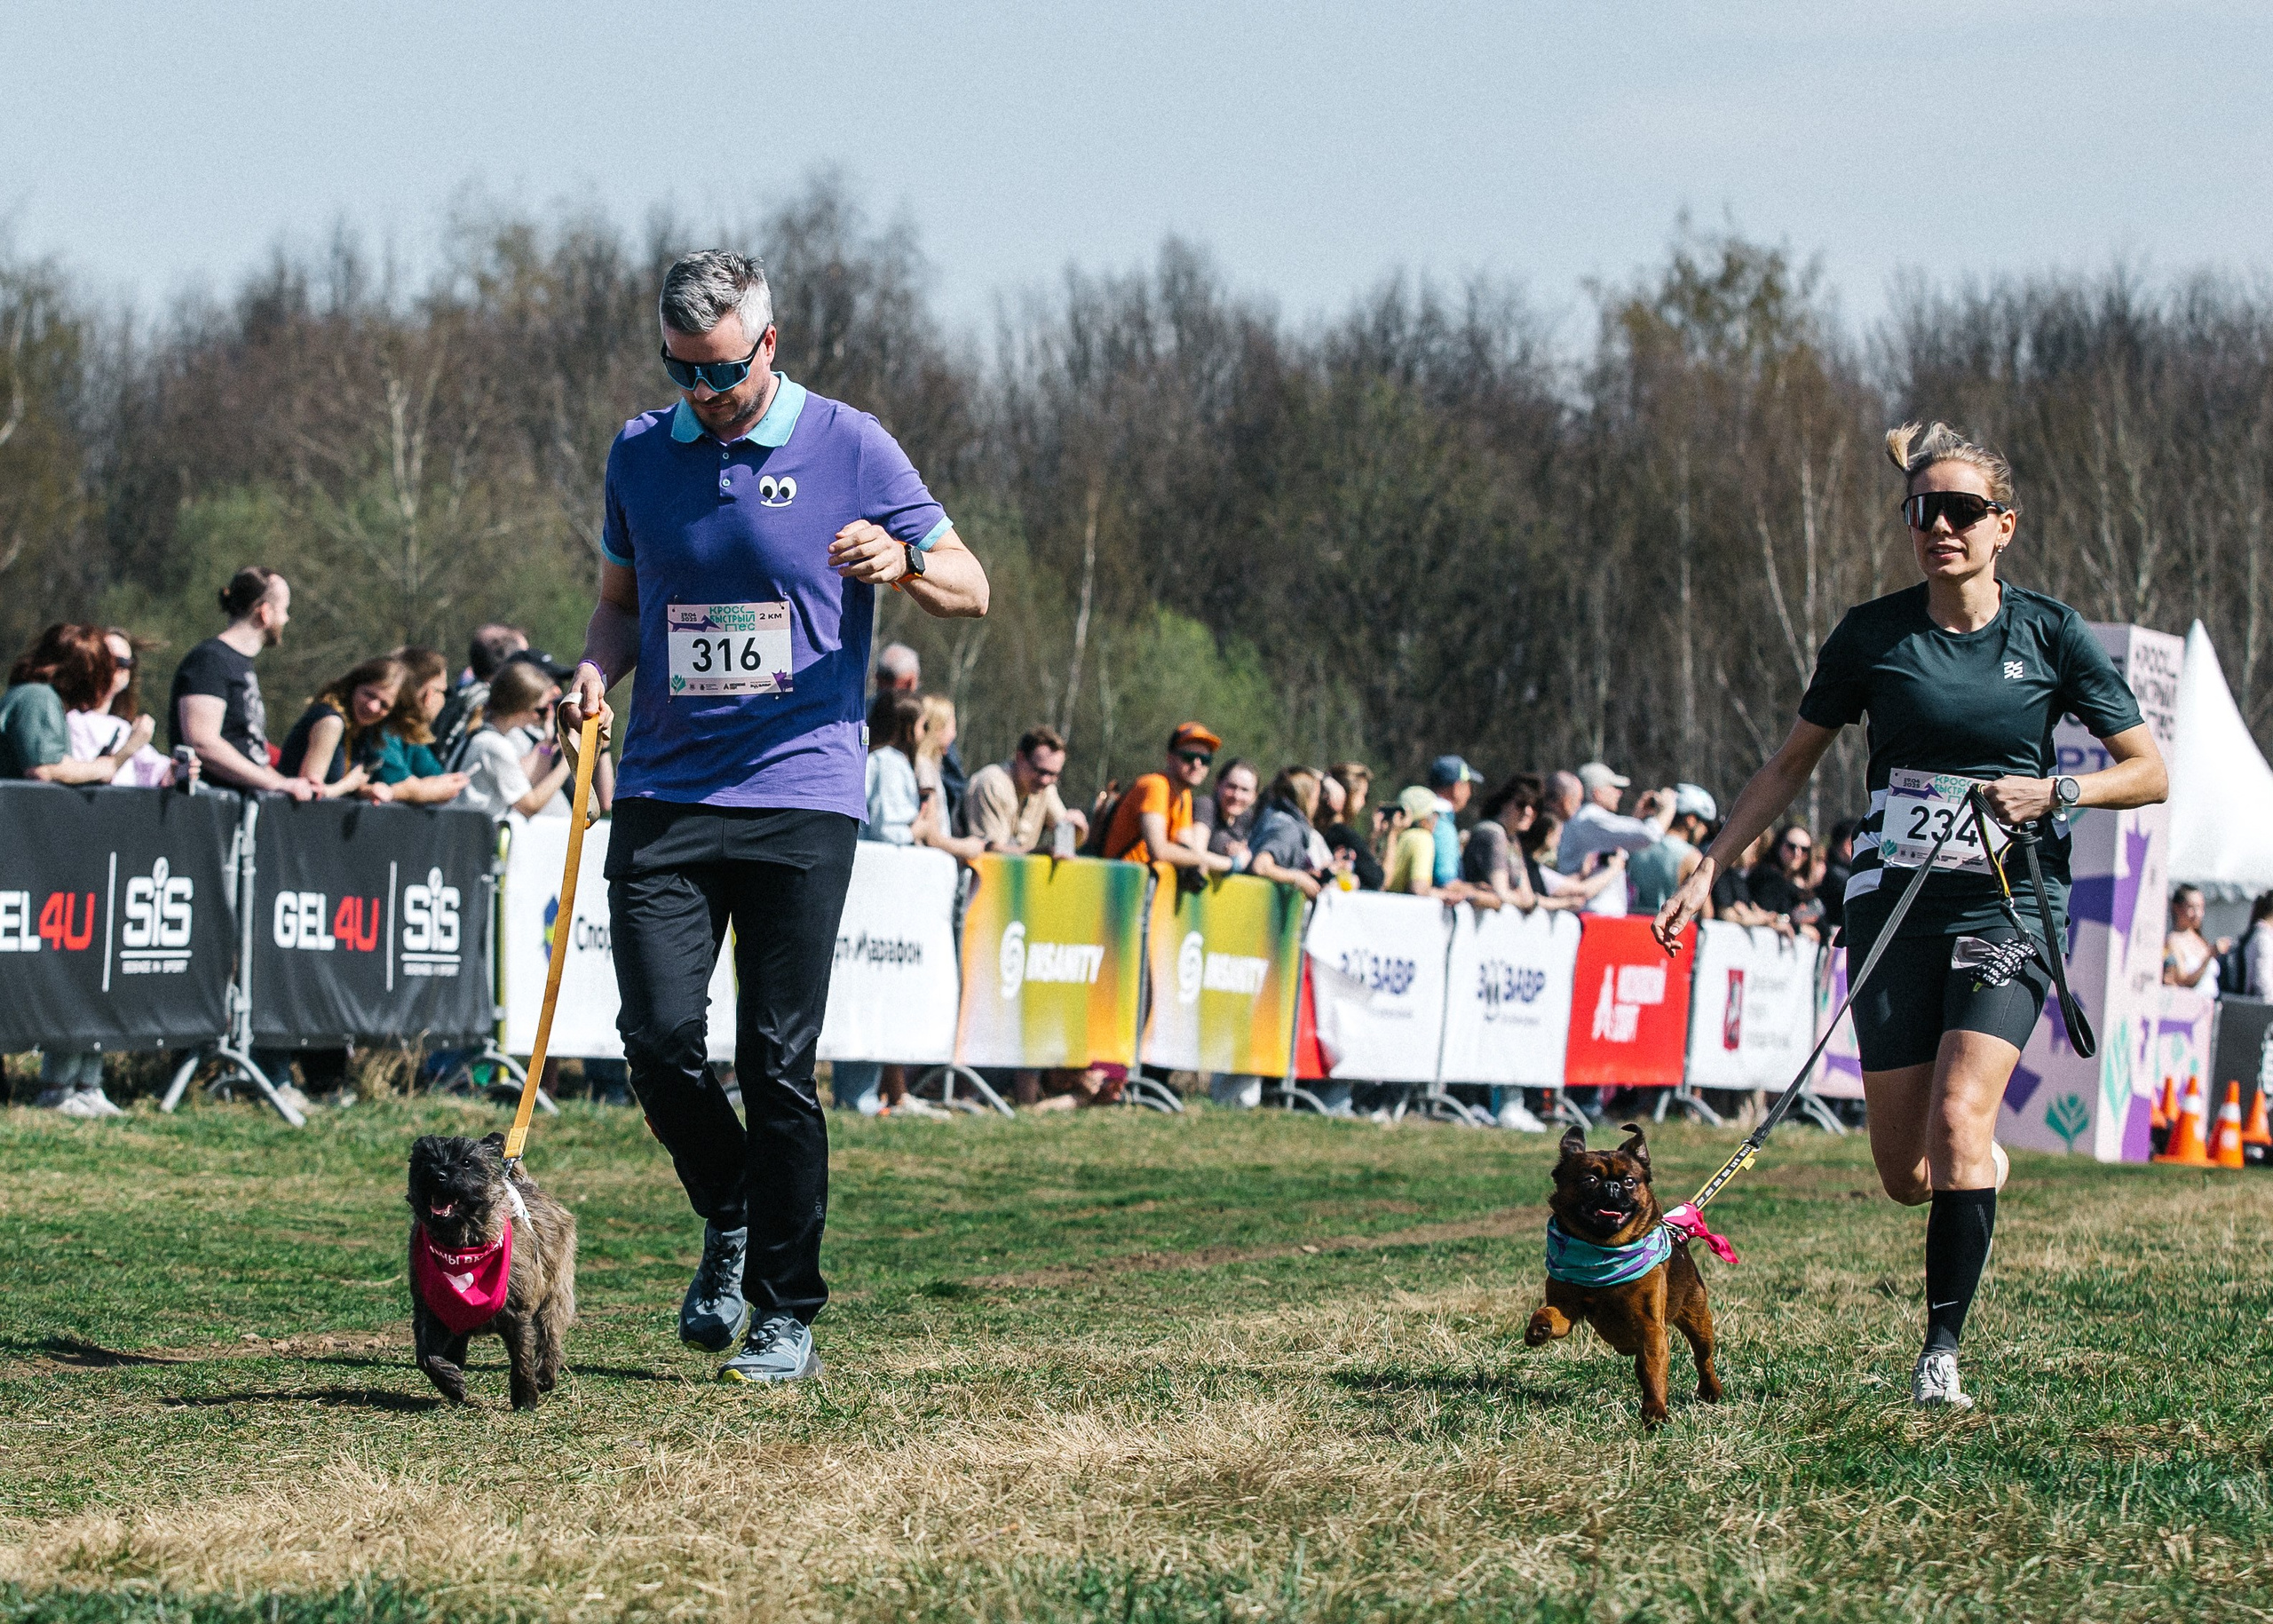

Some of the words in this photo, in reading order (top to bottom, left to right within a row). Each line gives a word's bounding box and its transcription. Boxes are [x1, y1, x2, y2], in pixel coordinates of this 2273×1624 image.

[692, 637, 762, 673] 316
[1906, 805, 1979, 847] 234
[273, 891, 380, 952] GEL4U
